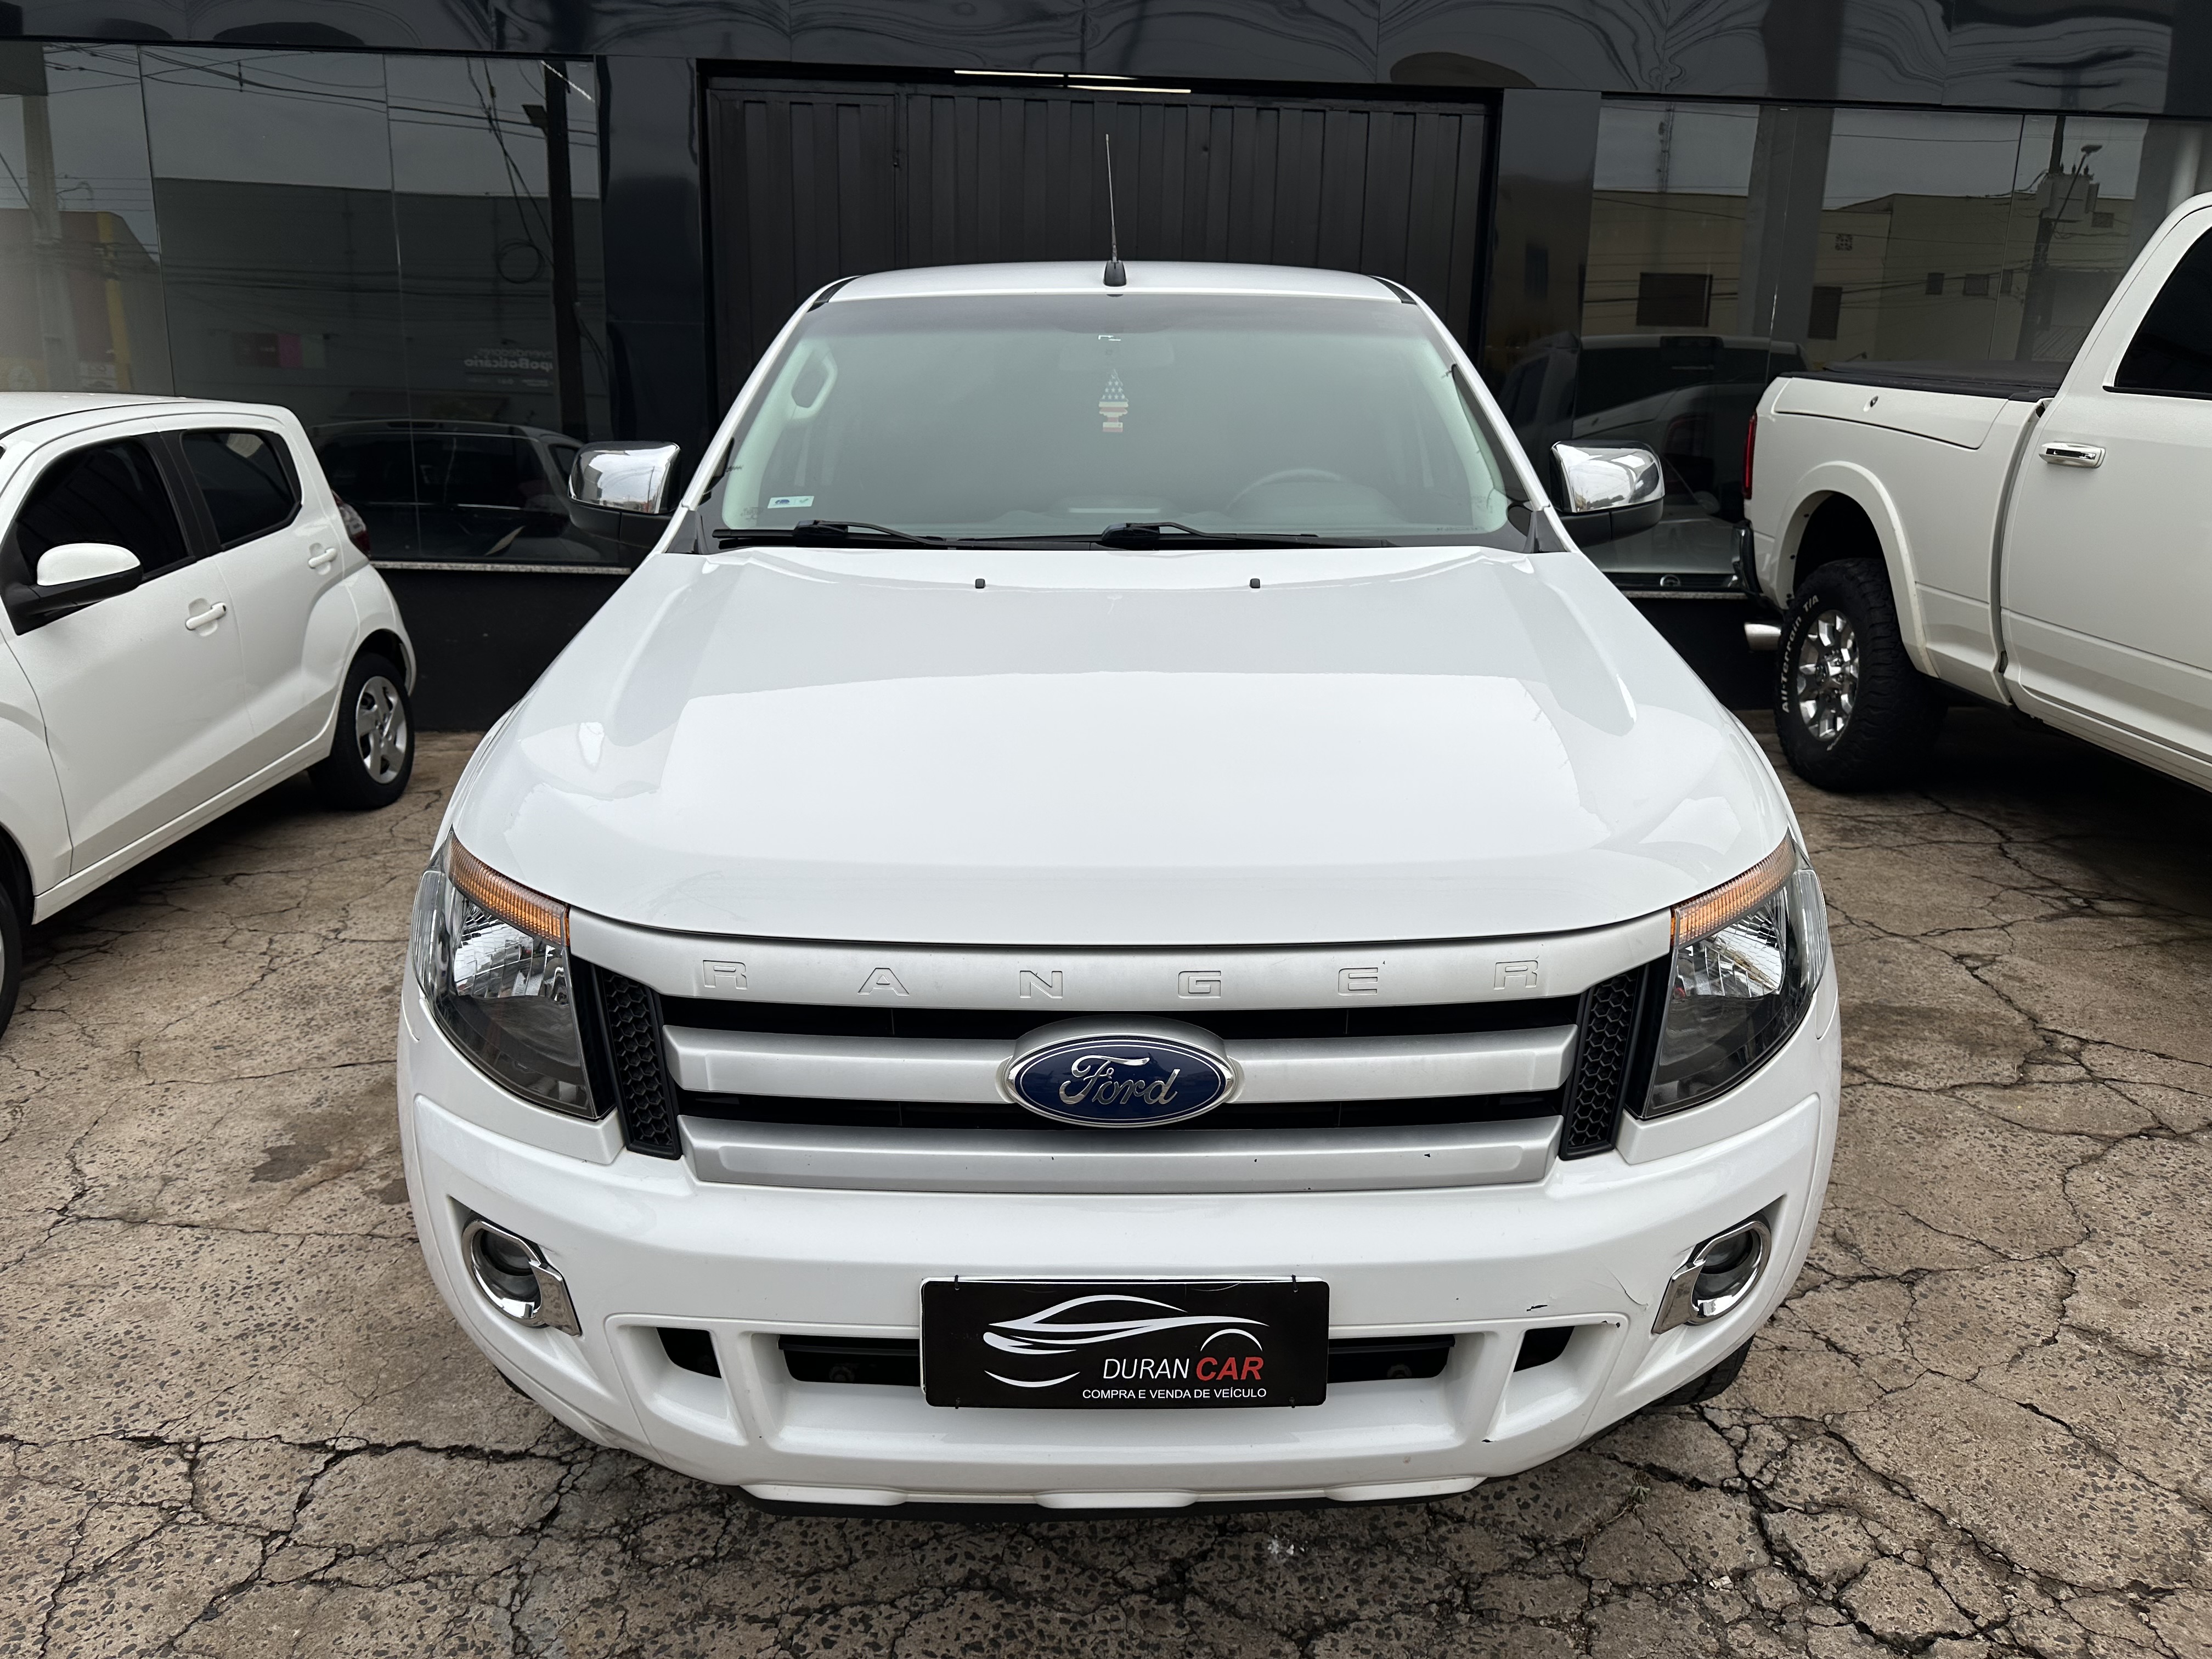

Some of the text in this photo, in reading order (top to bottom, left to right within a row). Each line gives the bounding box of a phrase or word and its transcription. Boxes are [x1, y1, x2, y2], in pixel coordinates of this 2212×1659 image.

[1803, 594, 1820, 613] T/A
[702, 959, 1539, 999] RANGER
[1058, 1054, 1181, 1105] Ford
[1103, 1356, 1264, 1381] DURAN CAR
[1082, 1387, 1267, 1399] COMPRA E VENDA DE VEÍCULO
